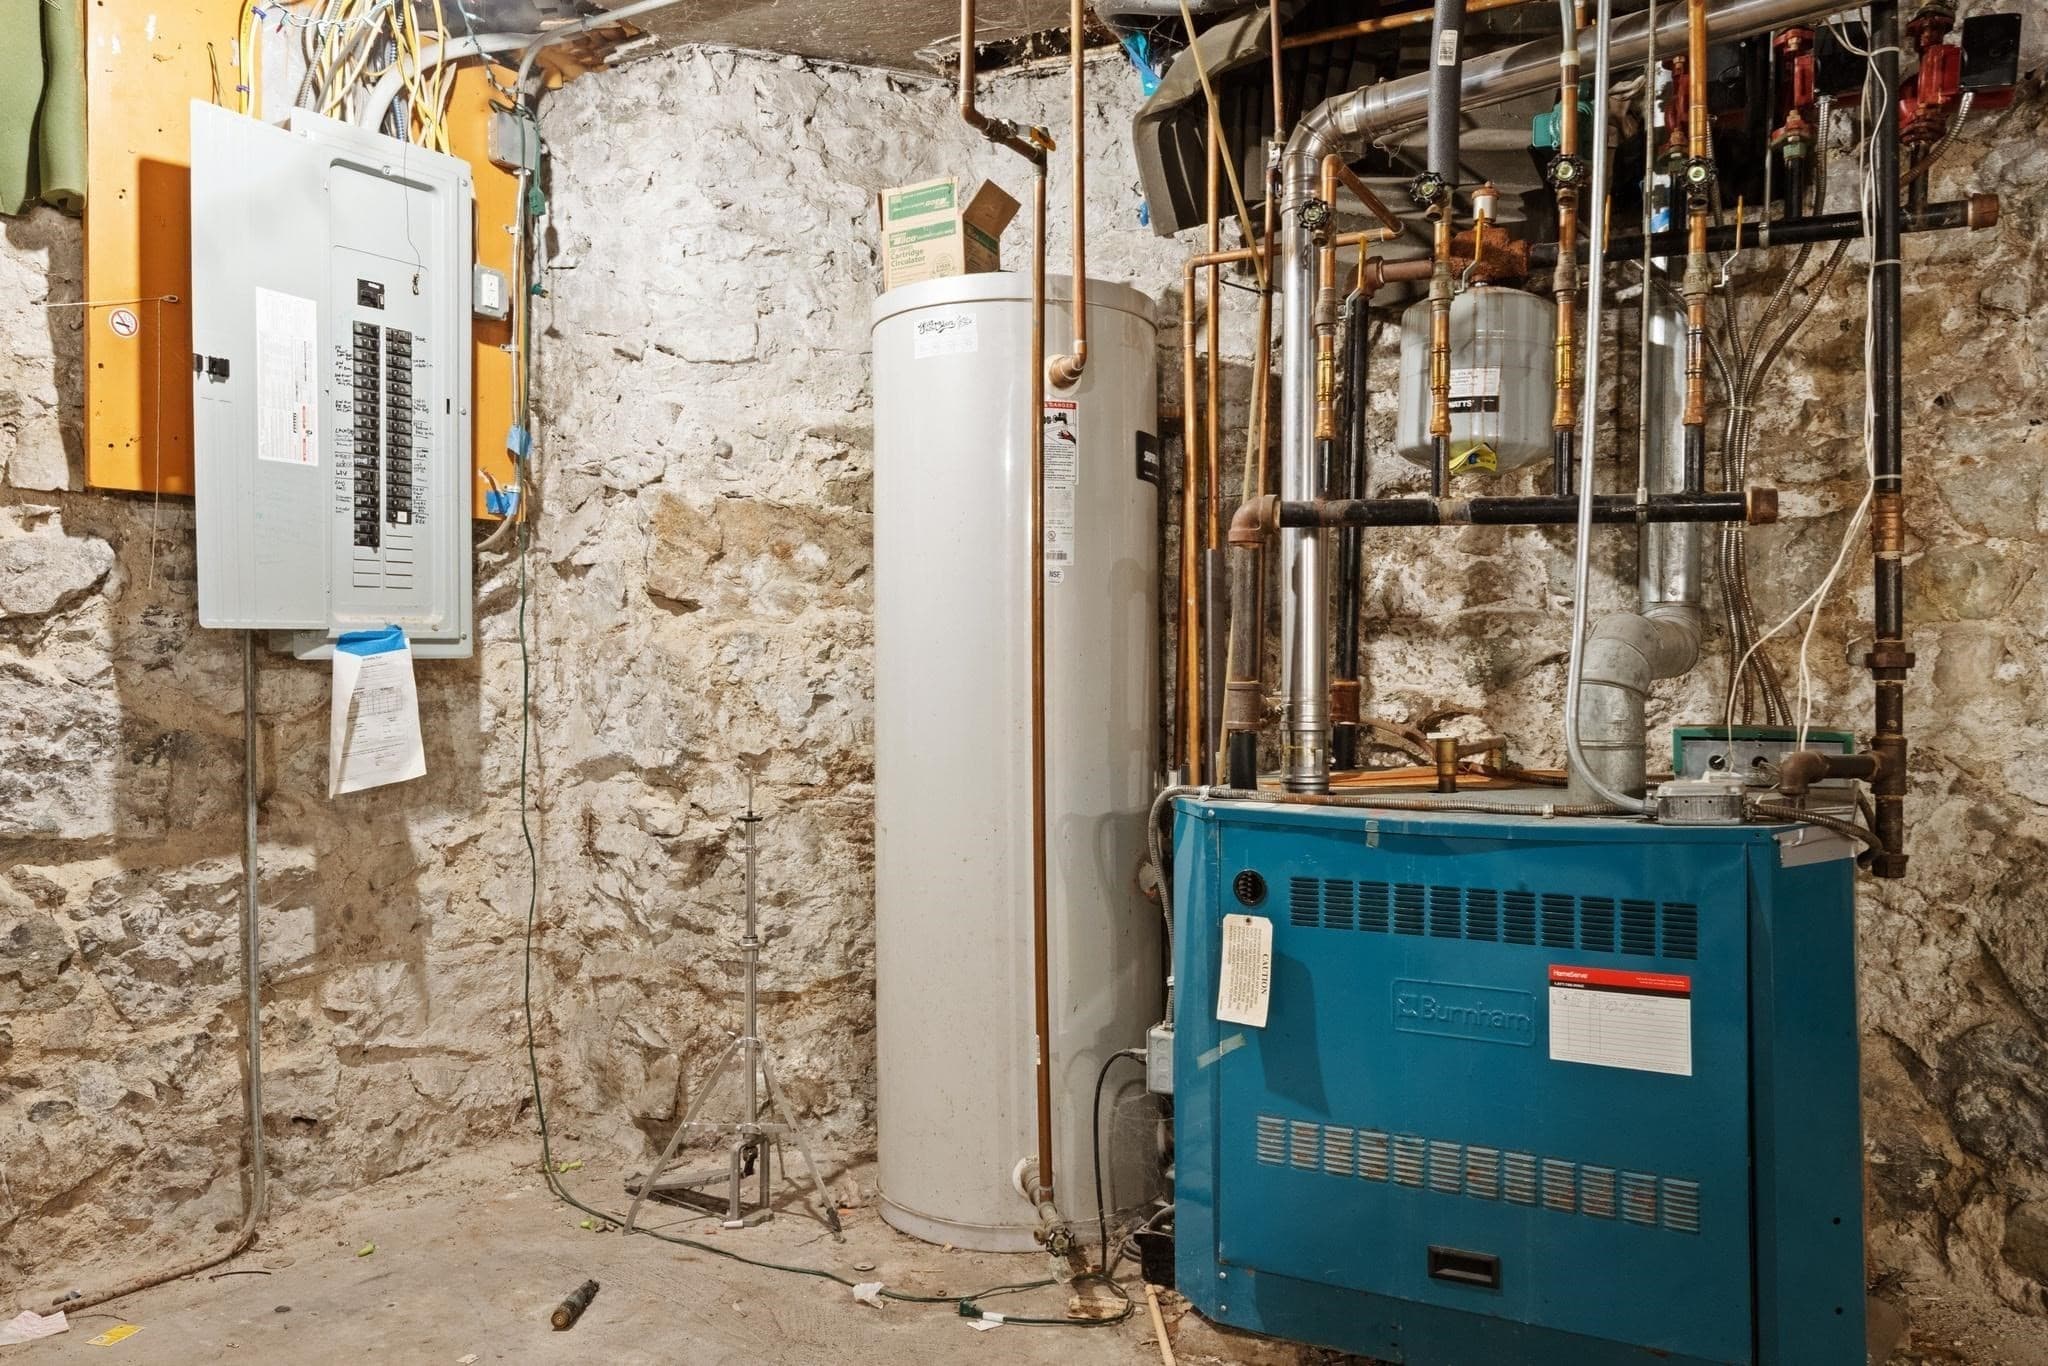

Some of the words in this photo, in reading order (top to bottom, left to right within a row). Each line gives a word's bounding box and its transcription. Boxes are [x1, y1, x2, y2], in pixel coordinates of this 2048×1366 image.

[891, 248, 924, 260] Cartridge
[891, 255, 926, 267] Circulator
[1261, 953, 1270, 995] CAUTION
[1421, 994, 1532, 1031] Burnham
